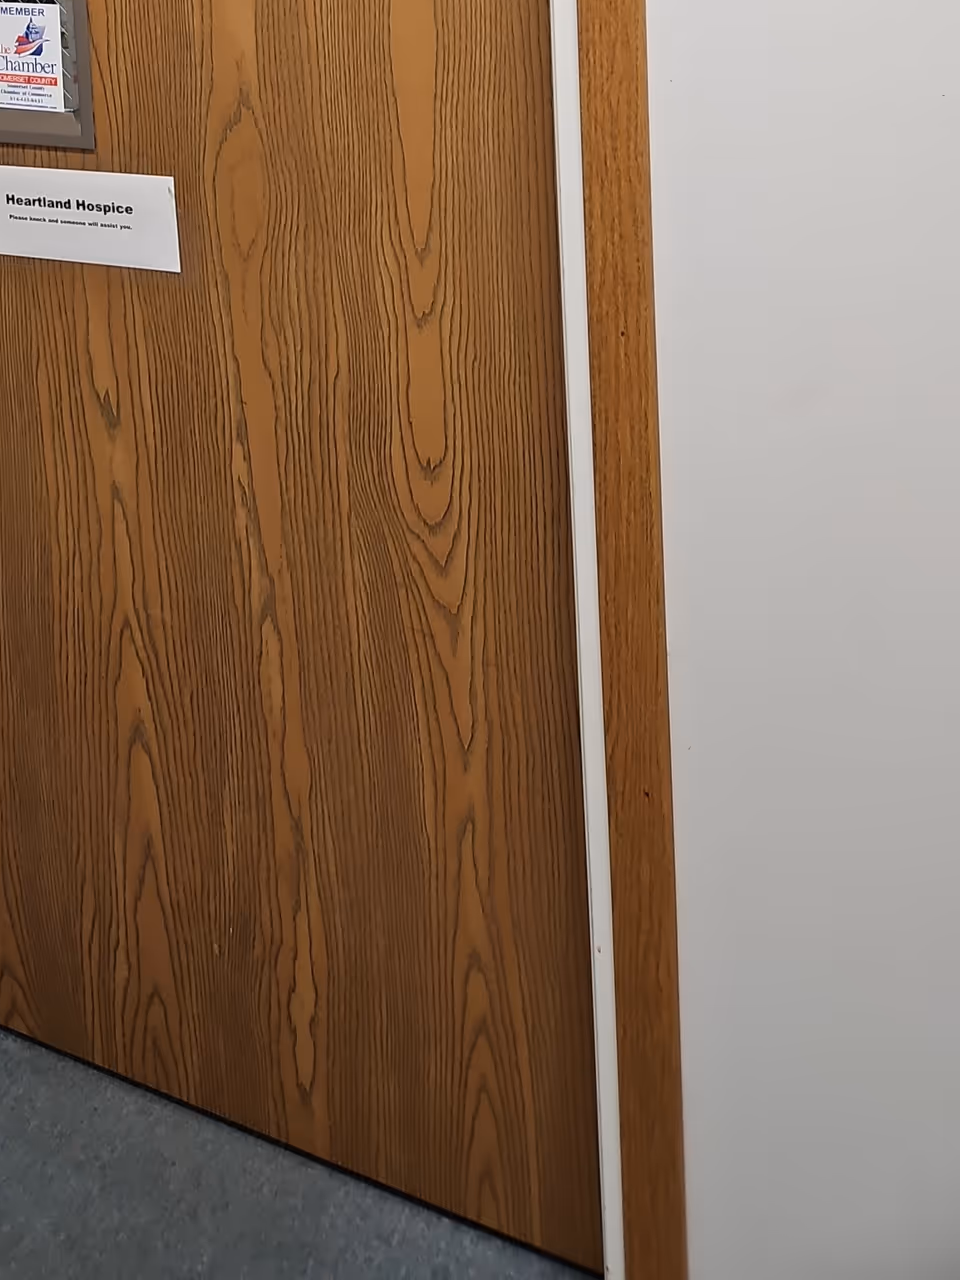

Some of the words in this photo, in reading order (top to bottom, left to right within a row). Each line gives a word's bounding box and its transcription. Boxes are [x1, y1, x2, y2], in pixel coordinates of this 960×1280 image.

[0, 6, 45, 17] MEMBER
[29, 76, 56, 85] COUNTY
[5, 193, 72, 210] Heartland
[76, 199, 134, 215] Hospice
